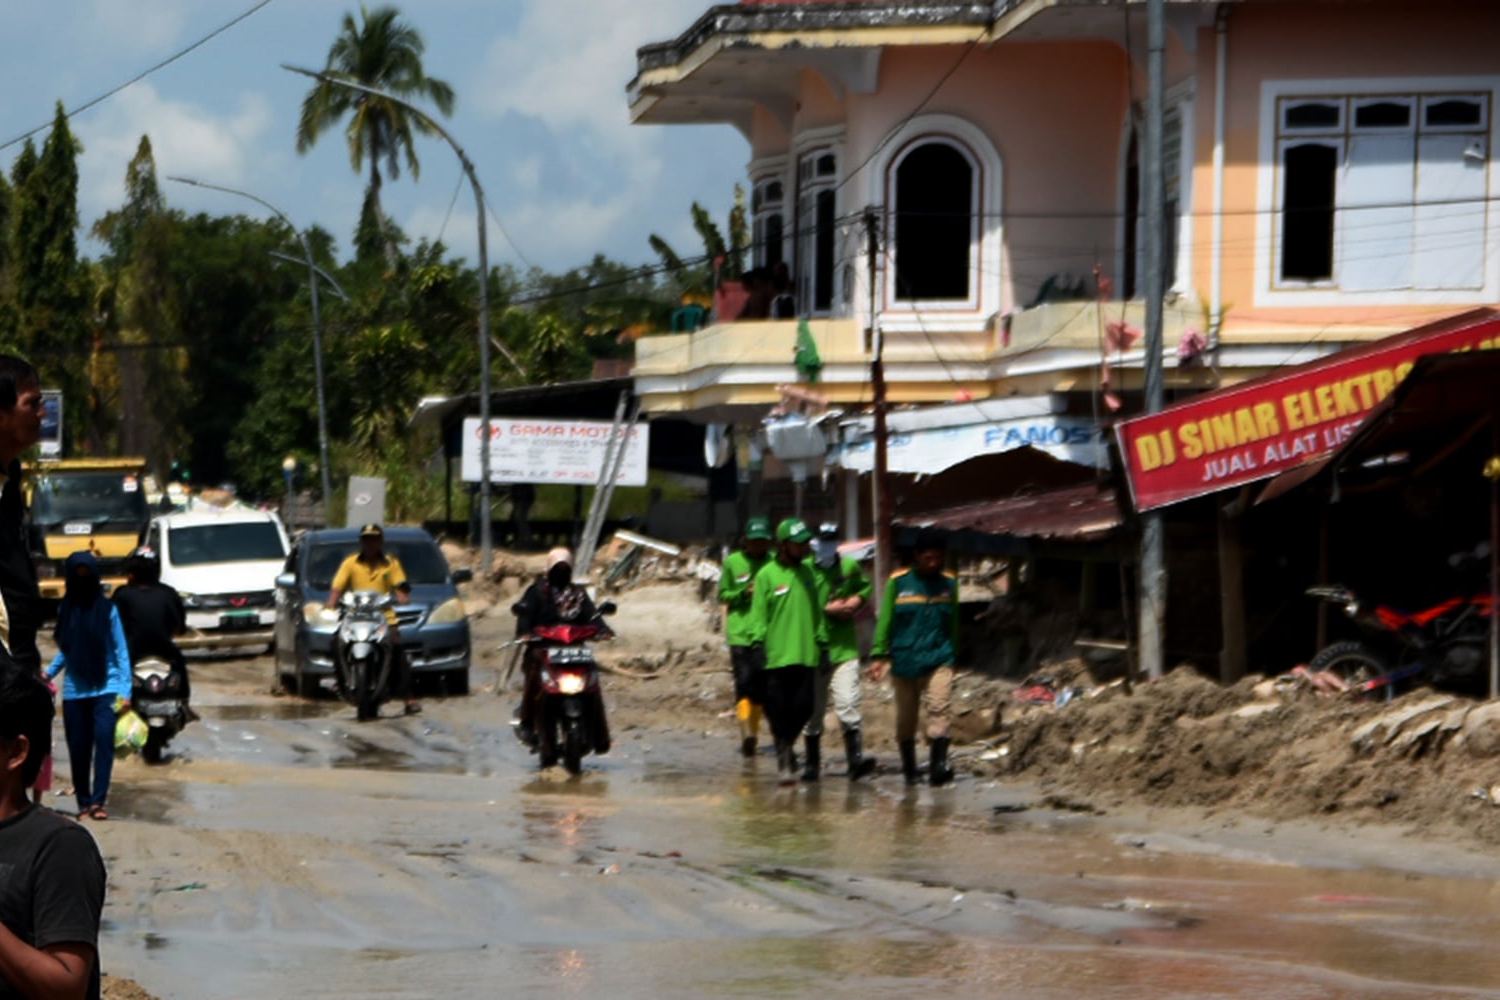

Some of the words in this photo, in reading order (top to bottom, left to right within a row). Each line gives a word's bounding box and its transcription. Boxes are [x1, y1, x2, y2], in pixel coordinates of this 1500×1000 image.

[1135, 429, 1176, 472] DJ
[1178, 402, 1281, 459] SINAR
[1202, 452, 1256, 481] JUAL
[1263, 433, 1317, 466] ALAT
